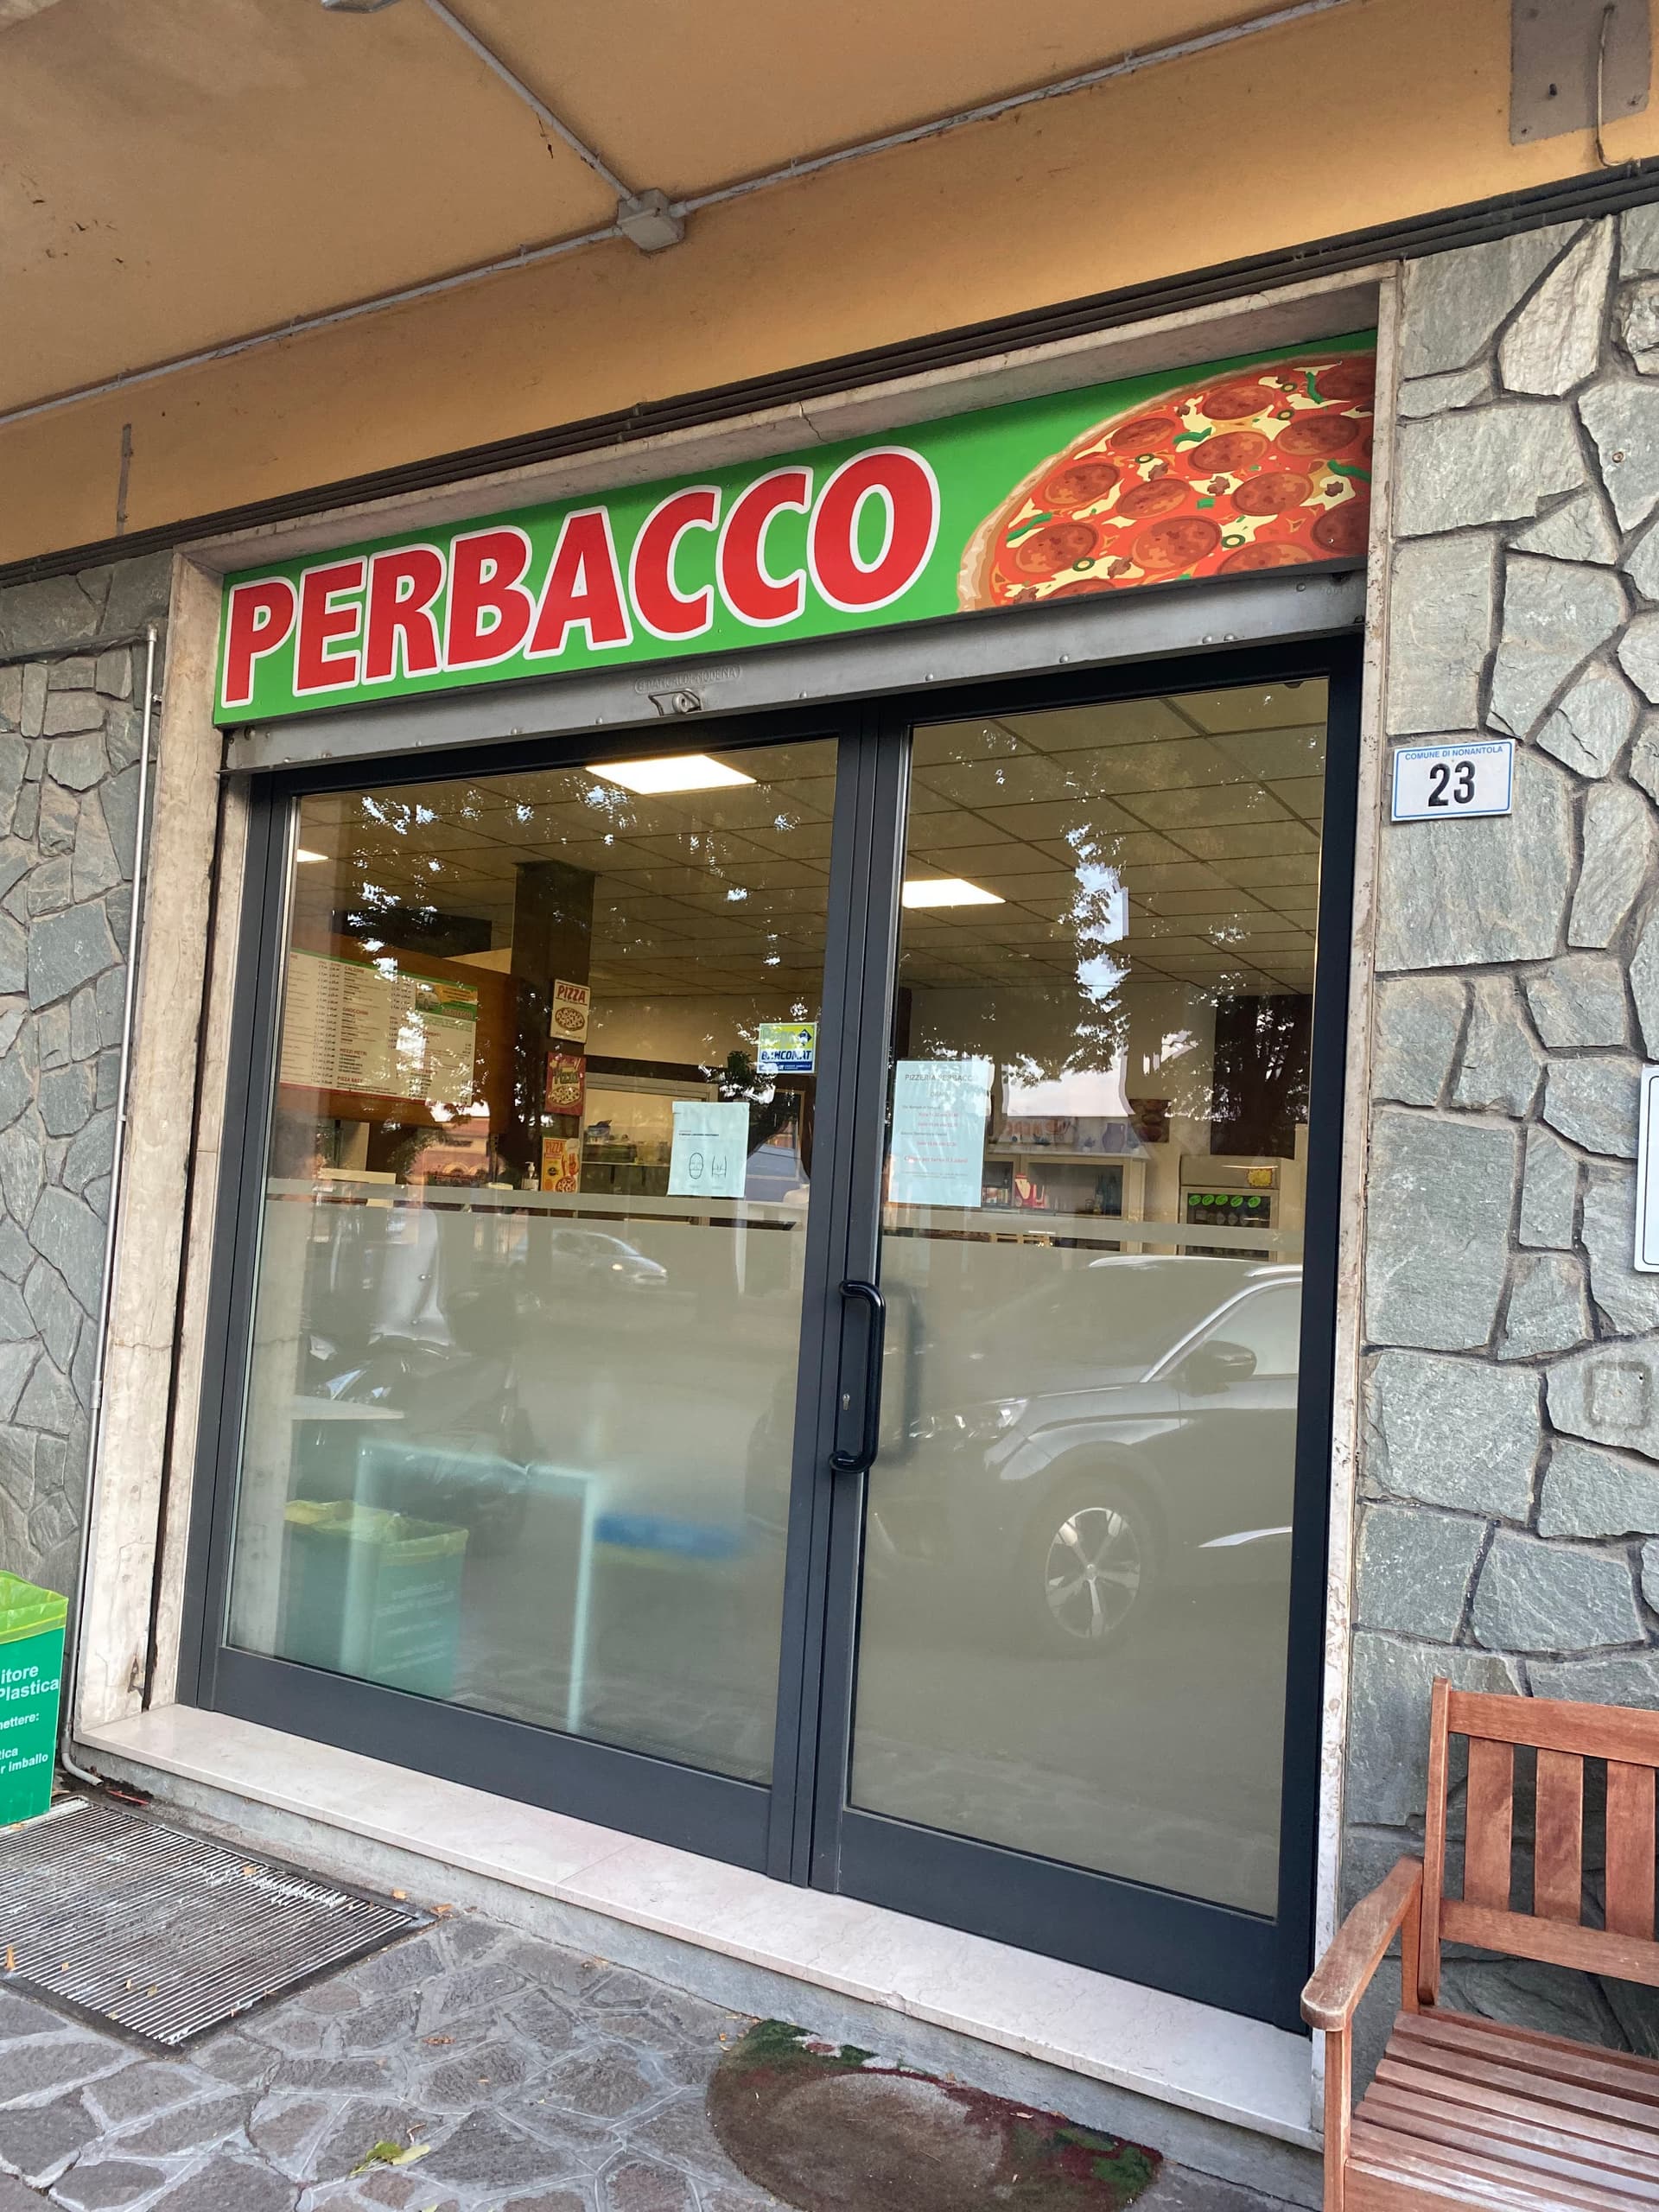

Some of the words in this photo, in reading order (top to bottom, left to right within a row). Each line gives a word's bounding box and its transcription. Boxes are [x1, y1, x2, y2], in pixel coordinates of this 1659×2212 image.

[222, 447, 939, 707] PERBACCO
[1405, 750, 1440, 760] COMUNE
[1452, 746, 1503, 756] NONANTOLA
[1428, 760, 1476, 807] 23
[557, 985, 586, 1003] PIZZA
[9, 1753, 48, 1772] imballo
